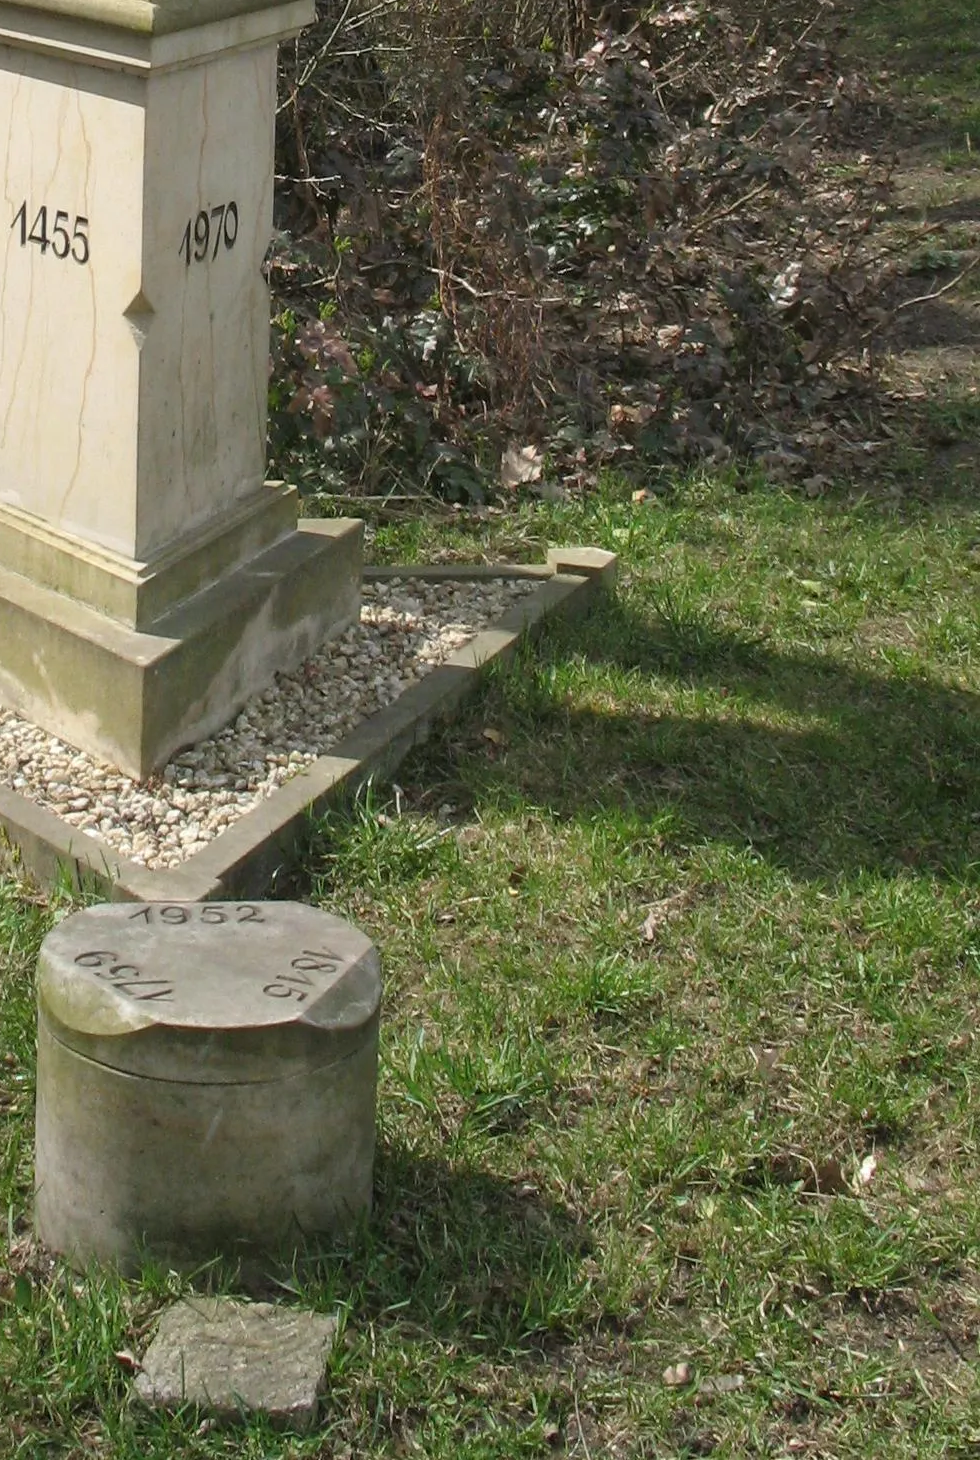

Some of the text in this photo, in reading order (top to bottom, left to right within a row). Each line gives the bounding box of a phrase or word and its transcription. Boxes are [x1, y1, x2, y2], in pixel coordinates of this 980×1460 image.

[10, 199, 90, 265] 1455
[178, 200, 239, 267] 1970
[128, 904, 266, 926] 1952
[73, 949, 175, 1003] 1759
[262, 945, 346, 1003] 1815
